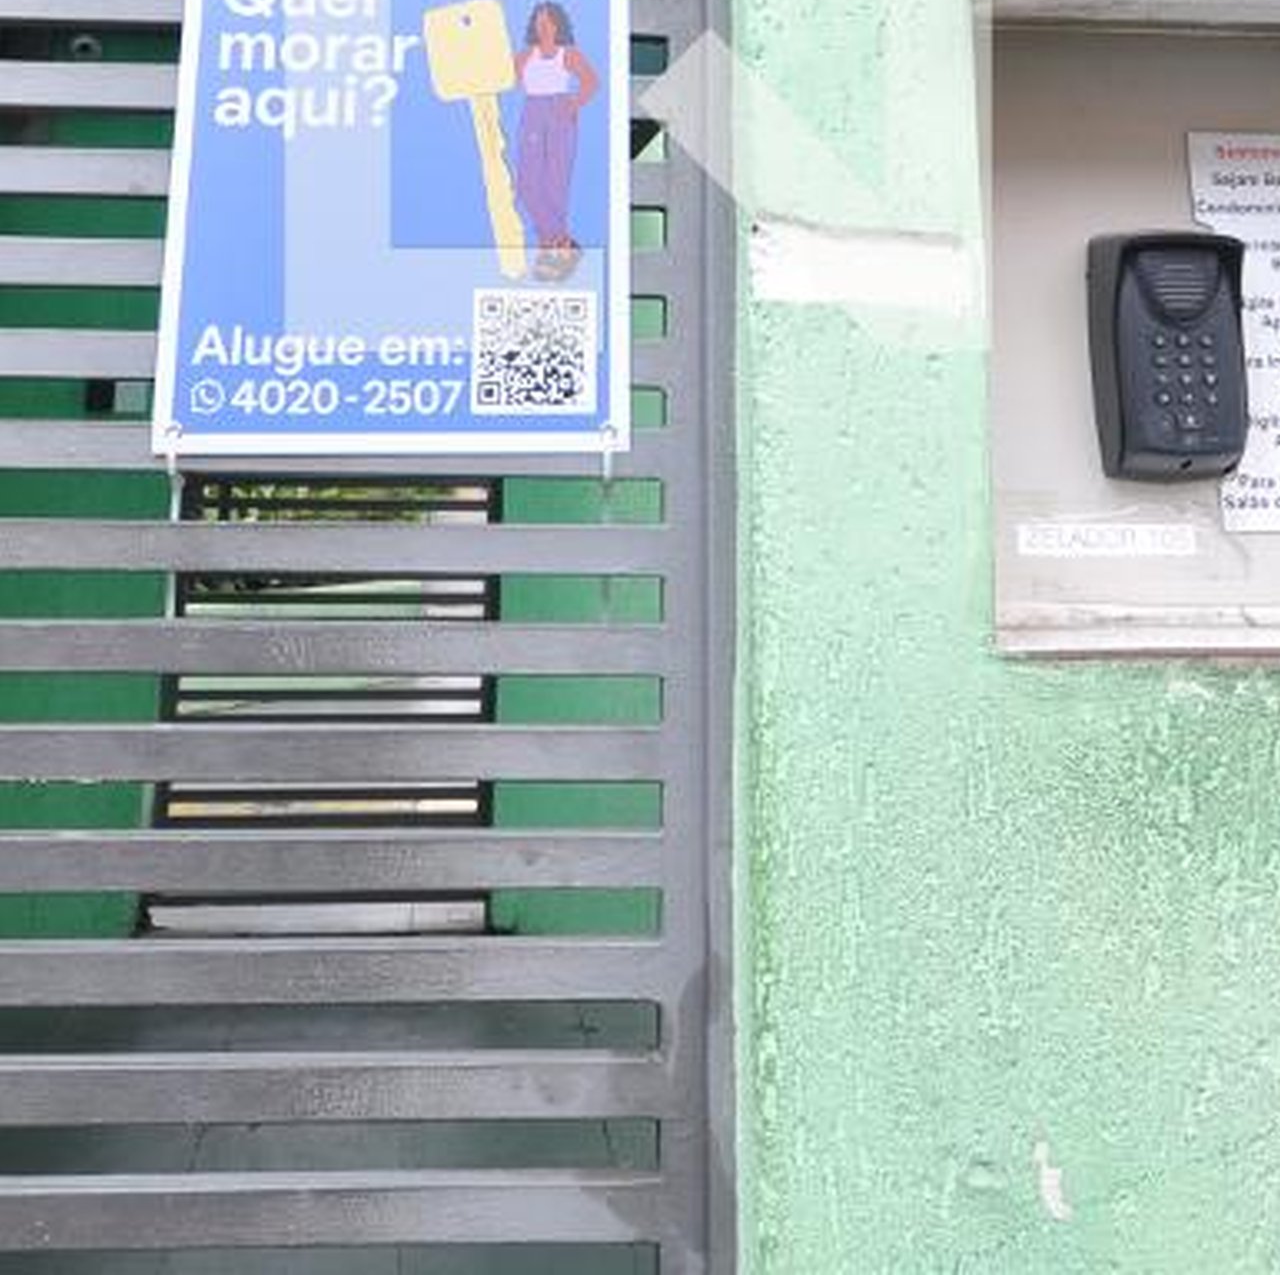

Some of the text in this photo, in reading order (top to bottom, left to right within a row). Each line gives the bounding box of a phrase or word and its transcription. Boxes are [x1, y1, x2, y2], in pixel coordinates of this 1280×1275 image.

[219, 27, 419, 74] morar
[213, 74, 398, 139] aqui?
[192, 324, 463, 377] Alugue em:
